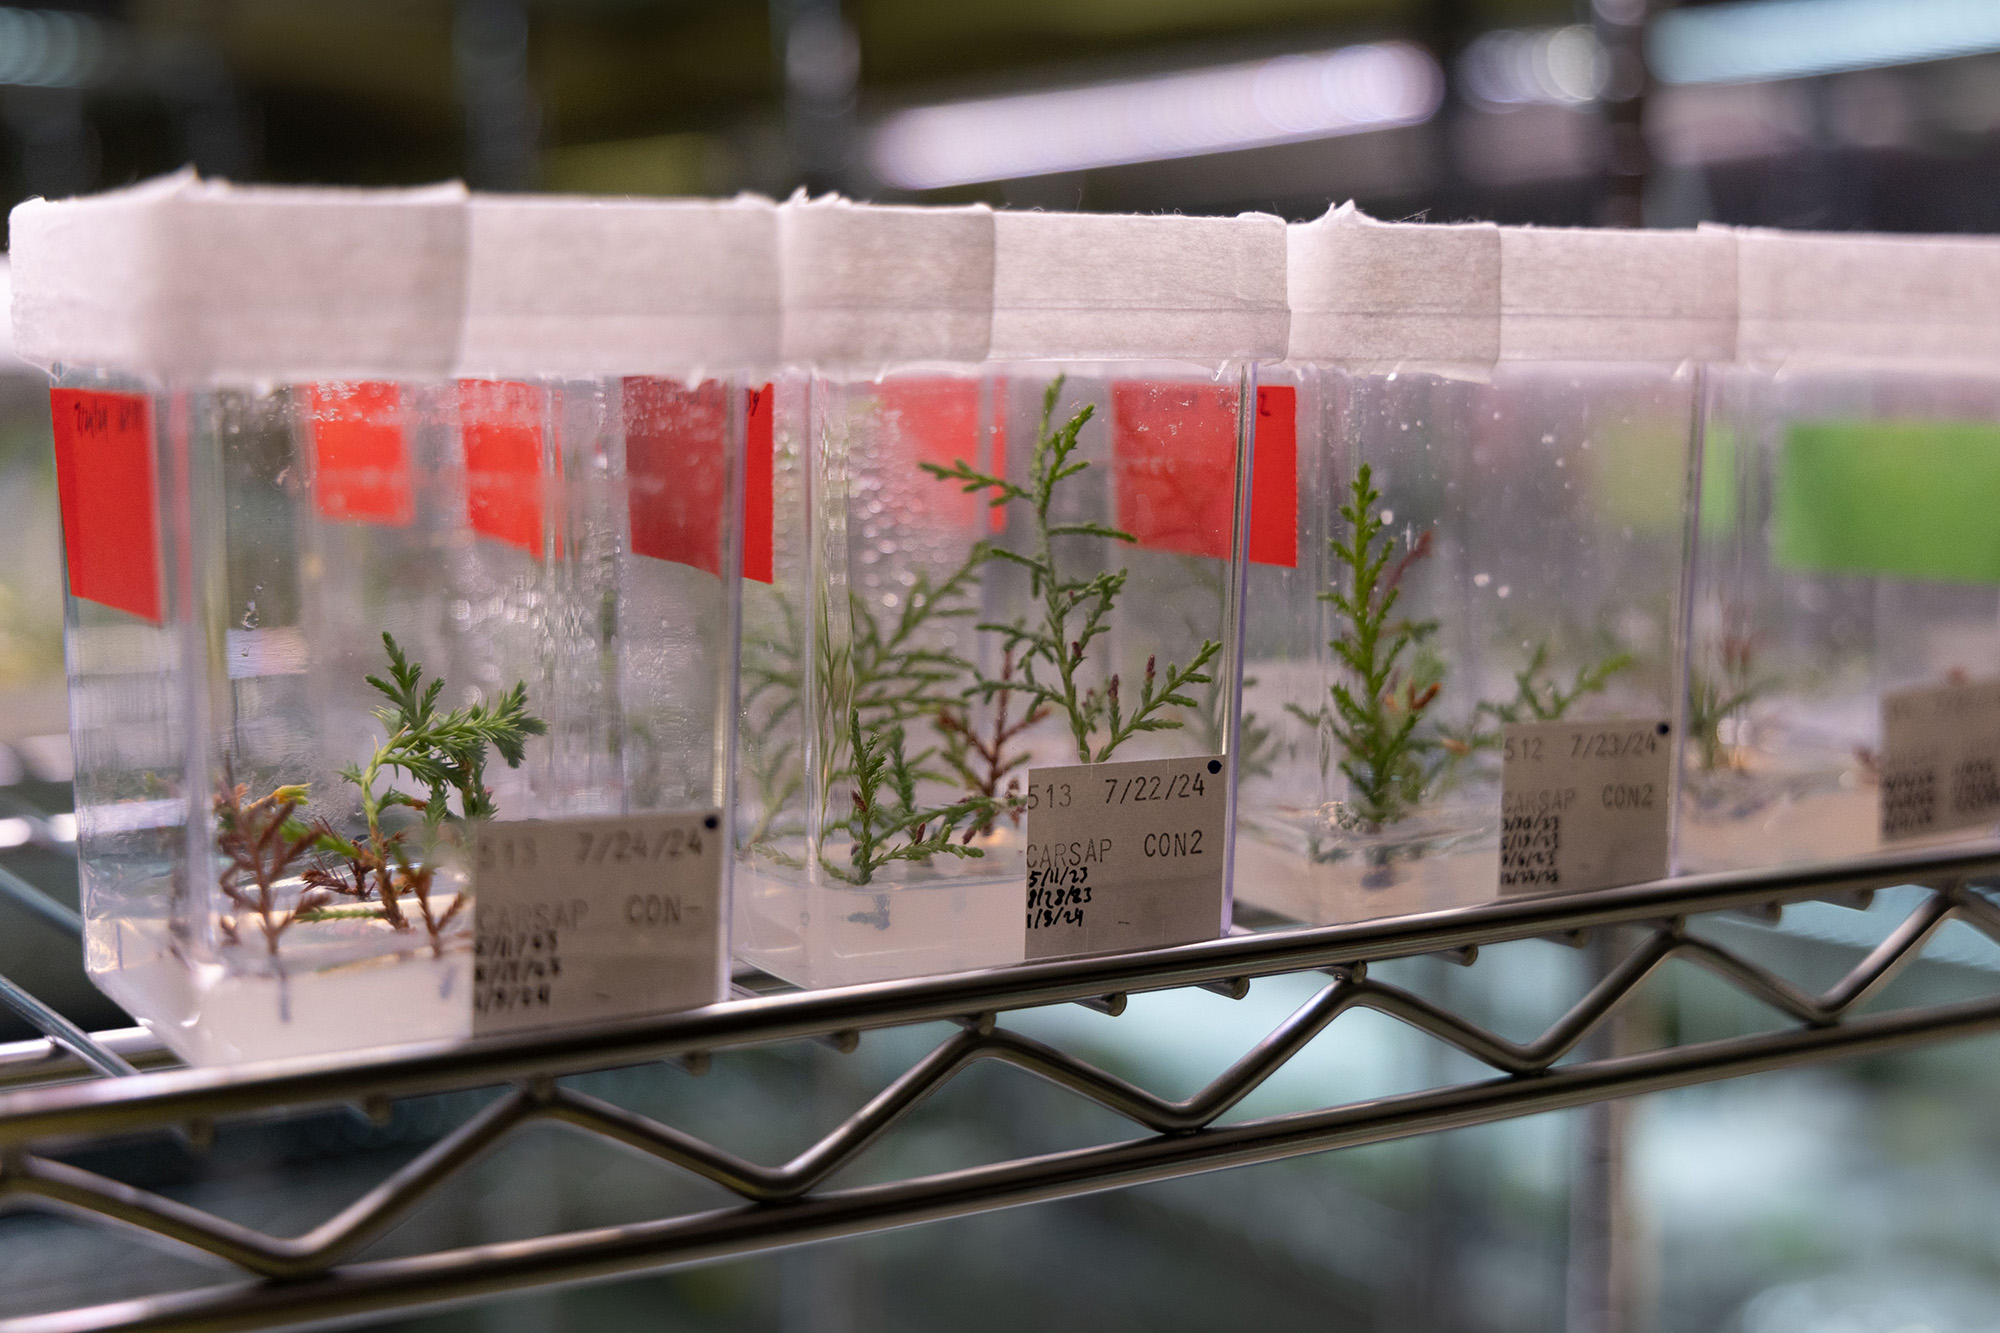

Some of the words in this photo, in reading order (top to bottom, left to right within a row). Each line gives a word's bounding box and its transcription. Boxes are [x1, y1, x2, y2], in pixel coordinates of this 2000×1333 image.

[1504, 737, 1543, 761] 512
[1570, 732, 1656, 759] 7/23/24
[1028, 784, 1072, 809] 513
[1105, 773, 1205, 804] 7/22/24
[1602, 783, 1654, 809] CON2
[1027, 838, 1112, 869] CARSAP
[1144, 829, 1203, 857] CON2
[1028, 867, 1088, 888] 5/11/23
[626, 893, 702, 927] CON-
[1027, 886, 1092, 909] 8/28/23
